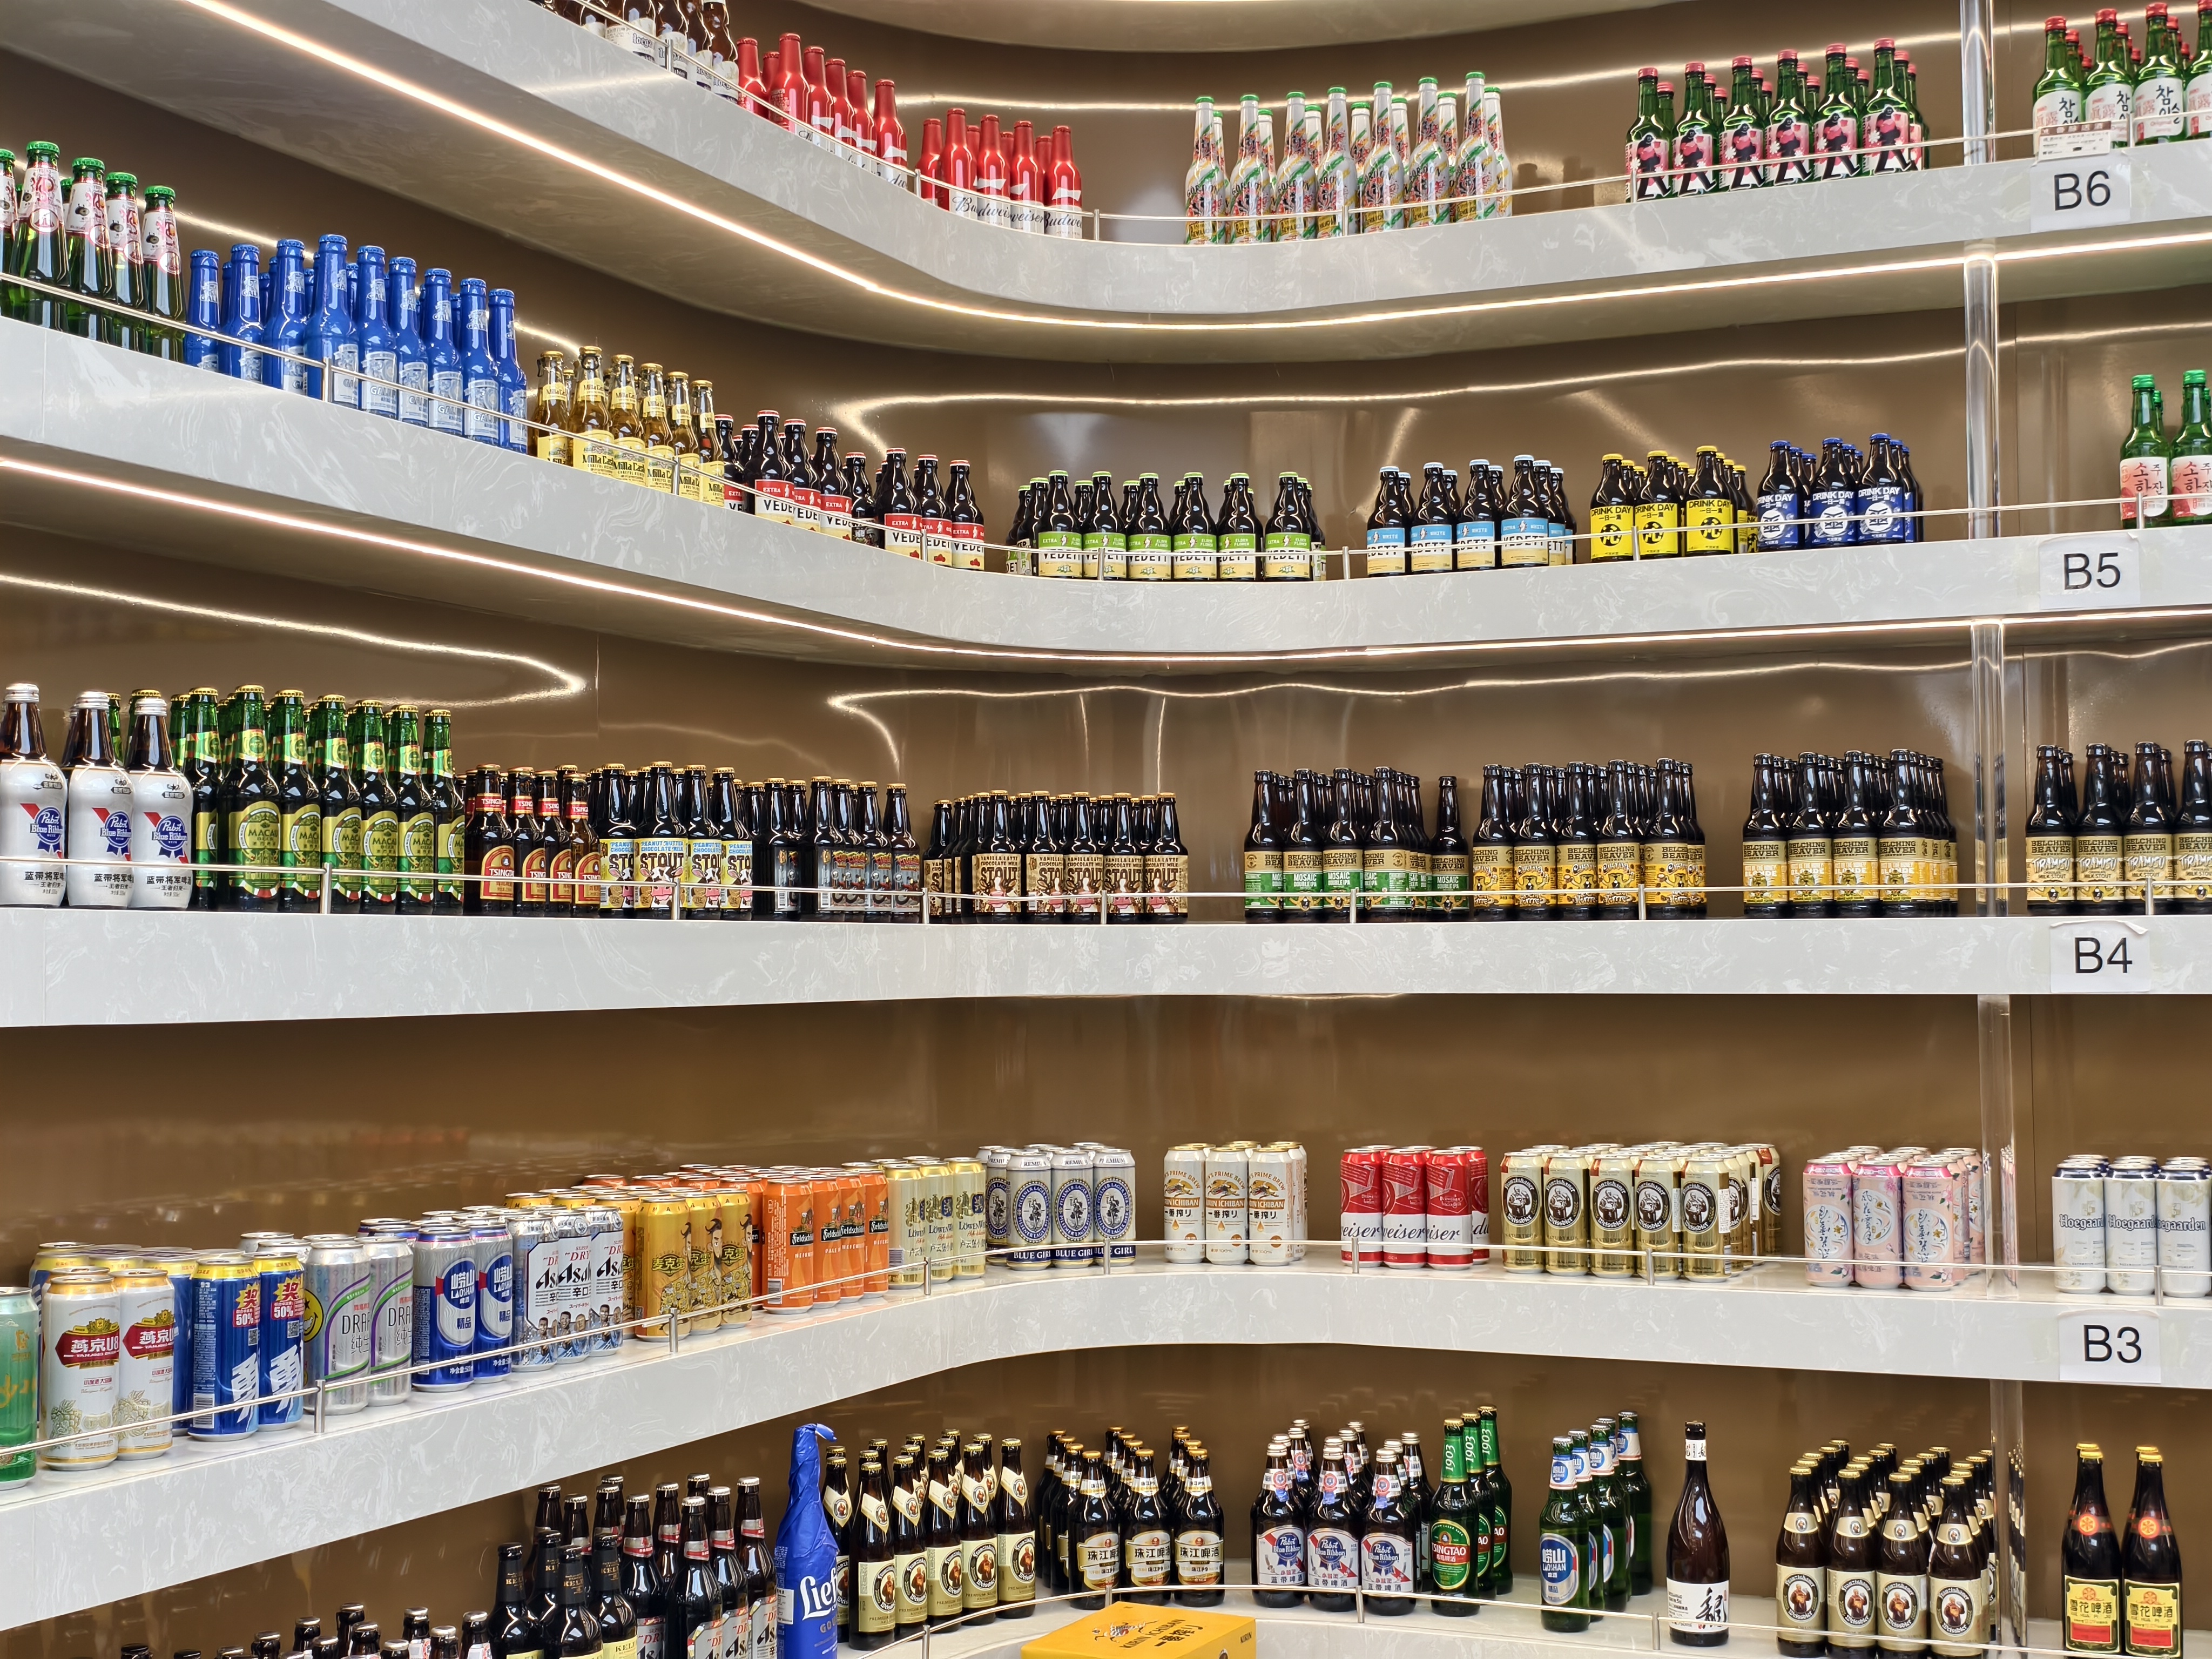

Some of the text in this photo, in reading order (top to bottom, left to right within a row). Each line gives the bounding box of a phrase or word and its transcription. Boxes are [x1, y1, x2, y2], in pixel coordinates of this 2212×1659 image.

[2156, 85, 2174, 105] 참
[2059, 97, 2075, 118] 참
[2054, 170, 2110, 211] B6
[1776, 493, 1793, 502] DAY
[1812, 491, 1854, 500] DRINK DAY
[1858, 487, 1900, 497] DRINK DAY
[1635, 503, 1675, 512] DRINK DAY
[1713, 500, 1730, 508] DAY
[1591, 505, 1632, 516] DRINK DAY
[2063, 552, 2121, 590] B5
[41, 812, 59, 824] Pabst
[110, 816, 128, 828] Pabst
[31, 824, 46, 833] Blue
[102, 828, 116, 837] Blue
[162, 820, 182, 833] Pabst
[153, 832, 167, 840] Blue
[640, 853, 684, 868] STOUT
[980, 867, 1017, 881] STOUT
[1067, 867, 1102, 881] STOUT
[1105, 868, 1142, 882] STOUT
[1328, 872, 1350, 880] MOSAIC
[2075, 937, 2132, 974] B4
[1176, 1197, 1199, 1206] ICHIBAN
[1218, 1198, 1244, 1207] ICHIBAN
[1259, 1198, 1285, 1208] ICHIBAN
[1208, 1209, 1239, 1218] 一番搾り
[1014, 1252, 1033, 1260] BLUE
[1055, 1250, 1075, 1258] BLUE
[1114, 1246, 1132, 1255] GIRL
[652, 1257, 685, 1271] 麦克雷
[451, 1269, 474, 1287] 崂山
[282, 1282, 298, 1301] 奖
[572, 1287, 589, 1297] 辛口
[245, 1289, 258, 1307] 奖
[274, 1305, 293, 1317] 50%
[236, 1313, 253, 1325] 50%
[71, 1339, 118, 1354] 燕京U8
[2083, 1324, 2141, 1364] B3
[1481, 1428, 1492, 1455] 1903
[1465, 1435, 1476, 1462] 1903
[1445, 1445, 1456, 1473] 1903
[1280, 1536, 1296, 1546] Pabst
[1321, 1540, 1337, 1549] Pabst
[1180, 1547, 1219, 1558] 珠江啤酒
[1316, 1547, 1327, 1555] Blue
[1375, 1544, 1391, 1554] Pabst
[1542, 1548, 1565, 1562] 崂山
[1370, 1552, 1380, 1560] Blue
[1314, 1578, 1347, 1588] 蓝带啤酒
[2070, 1600, 2112, 1615] 雪花啤酒
[2130, 1603, 2173, 1618] 雪花啤酒
[1119, 1618, 1186, 1649] KIRIN ICHIBAN
[1240, 1631, 1252, 1644] KIRIN
